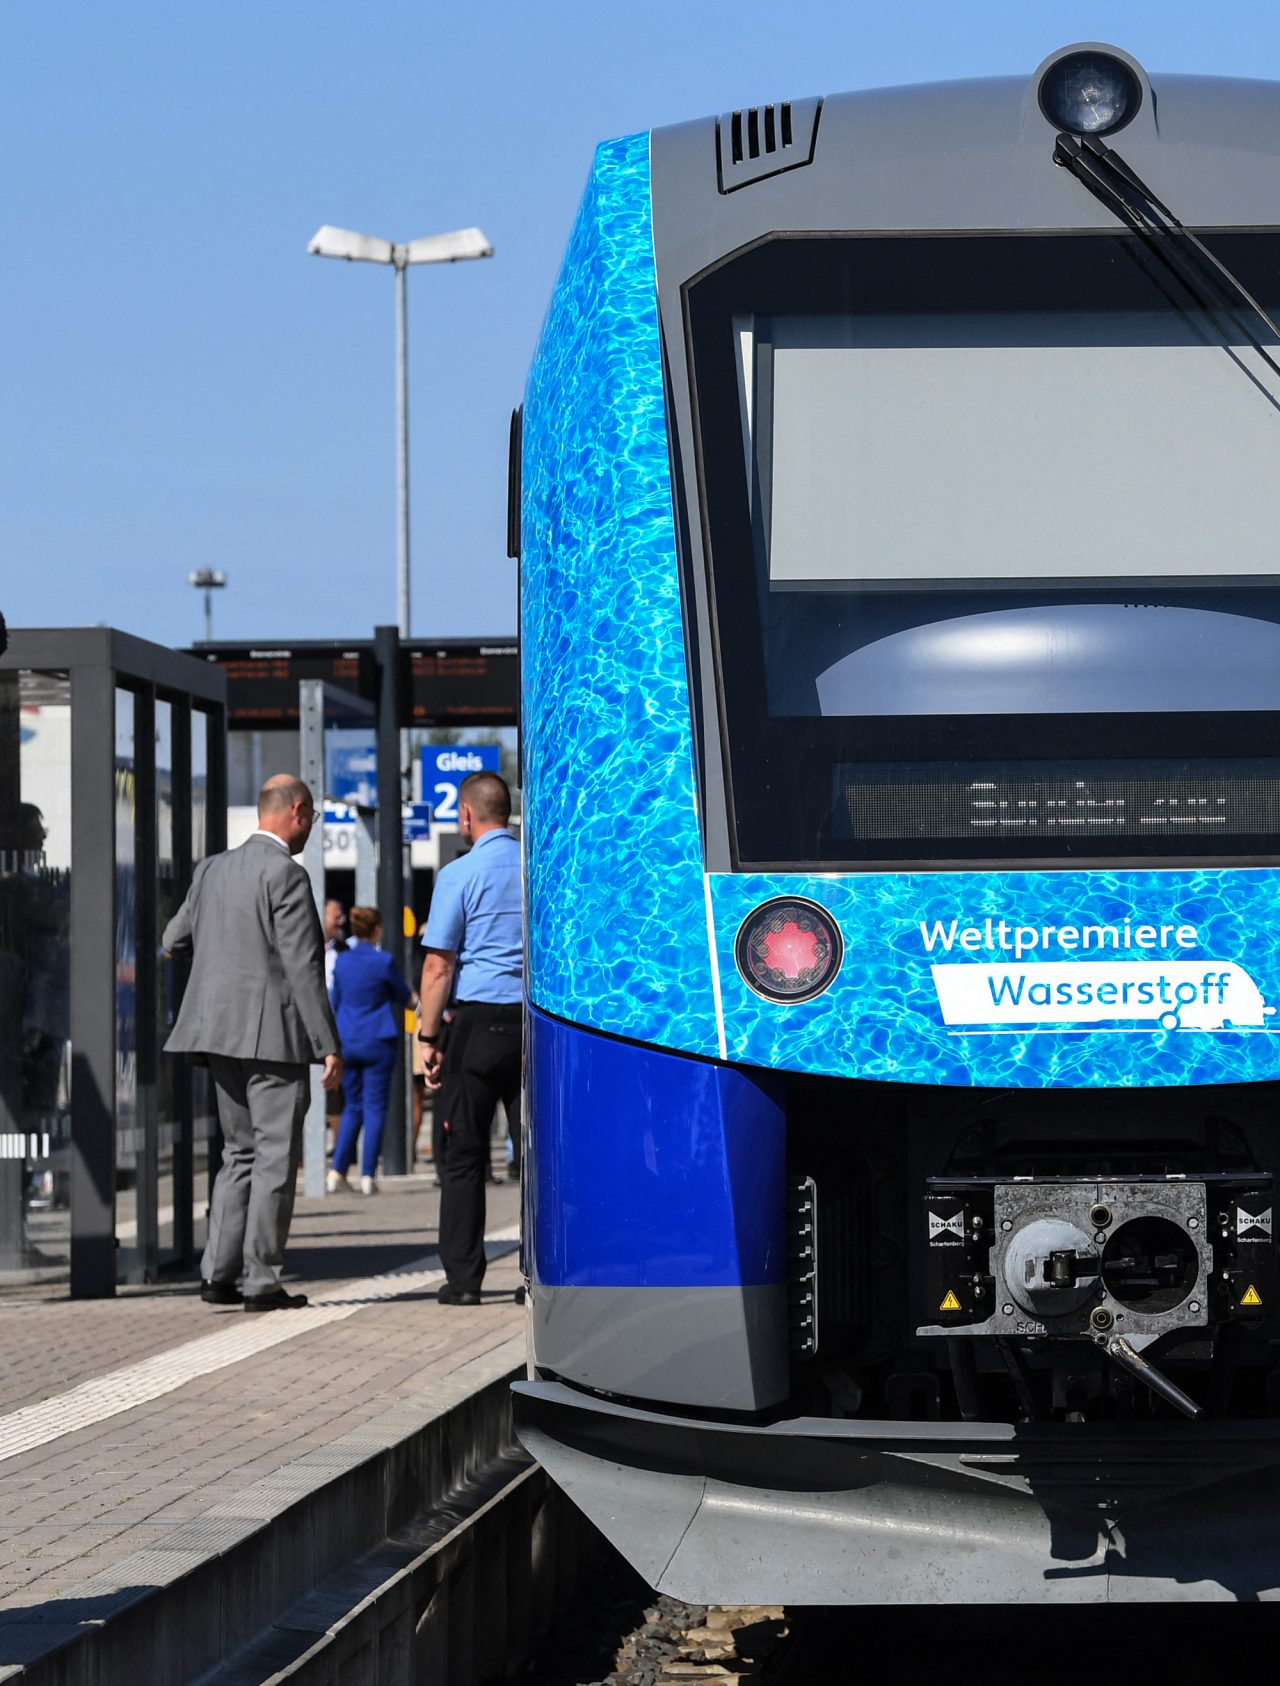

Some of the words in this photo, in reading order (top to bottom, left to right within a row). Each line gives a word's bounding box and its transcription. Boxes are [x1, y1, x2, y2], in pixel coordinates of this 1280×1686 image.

[436, 752, 483, 772] Gleis
[433, 782, 459, 819] 2
[920, 917, 1199, 959] Weltpremiere
[987, 972, 1231, 1007] Wasserstoff
[1238, 1217, 1271, 1225] SCHAKU
